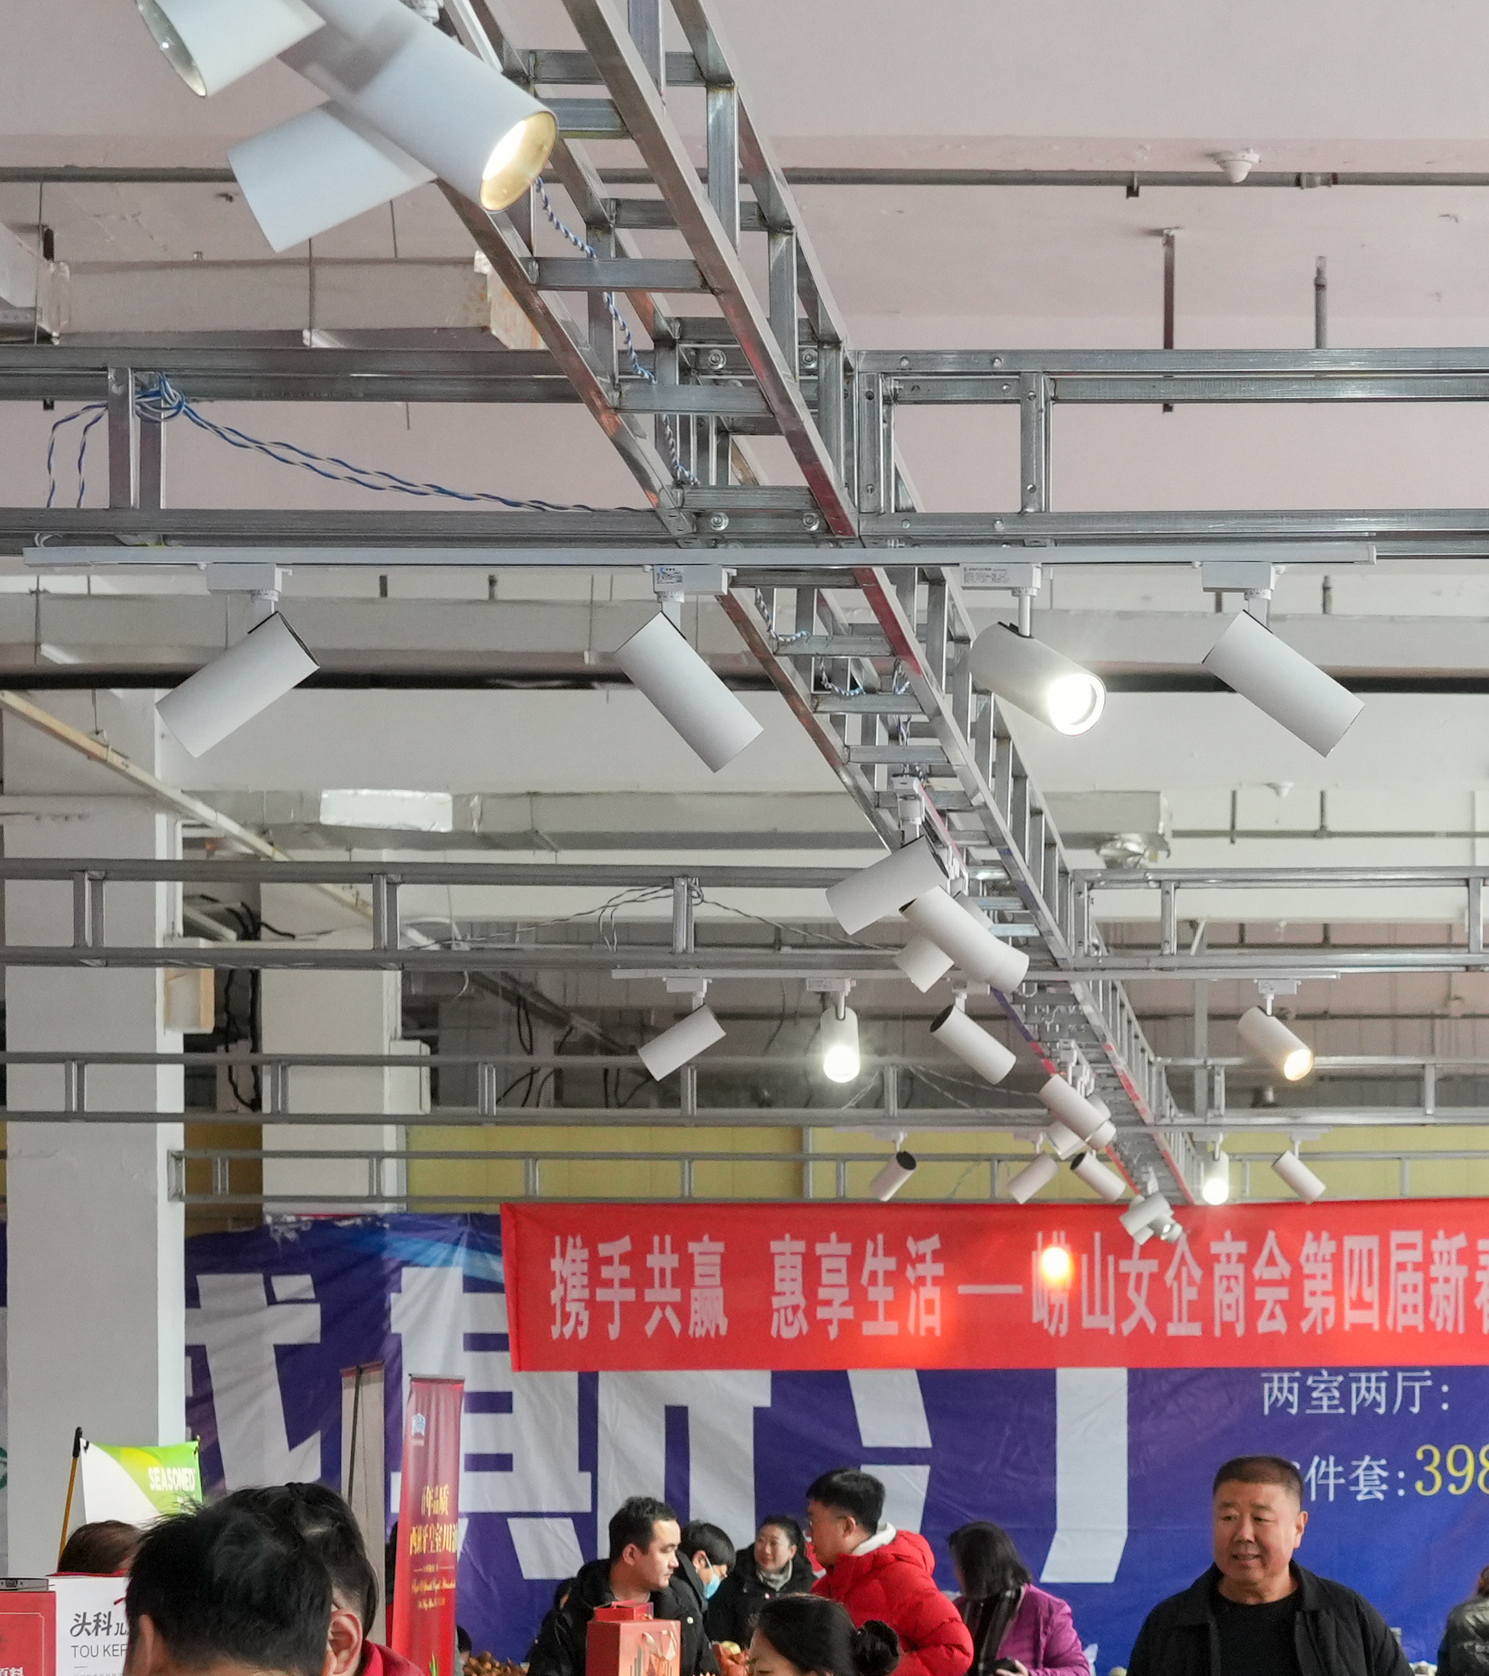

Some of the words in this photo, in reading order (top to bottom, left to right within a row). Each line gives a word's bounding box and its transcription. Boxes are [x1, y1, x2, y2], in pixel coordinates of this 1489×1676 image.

[550, 1232, 728, 1341] 携手共赢
[71, 1644, 99, 1658] TOU
